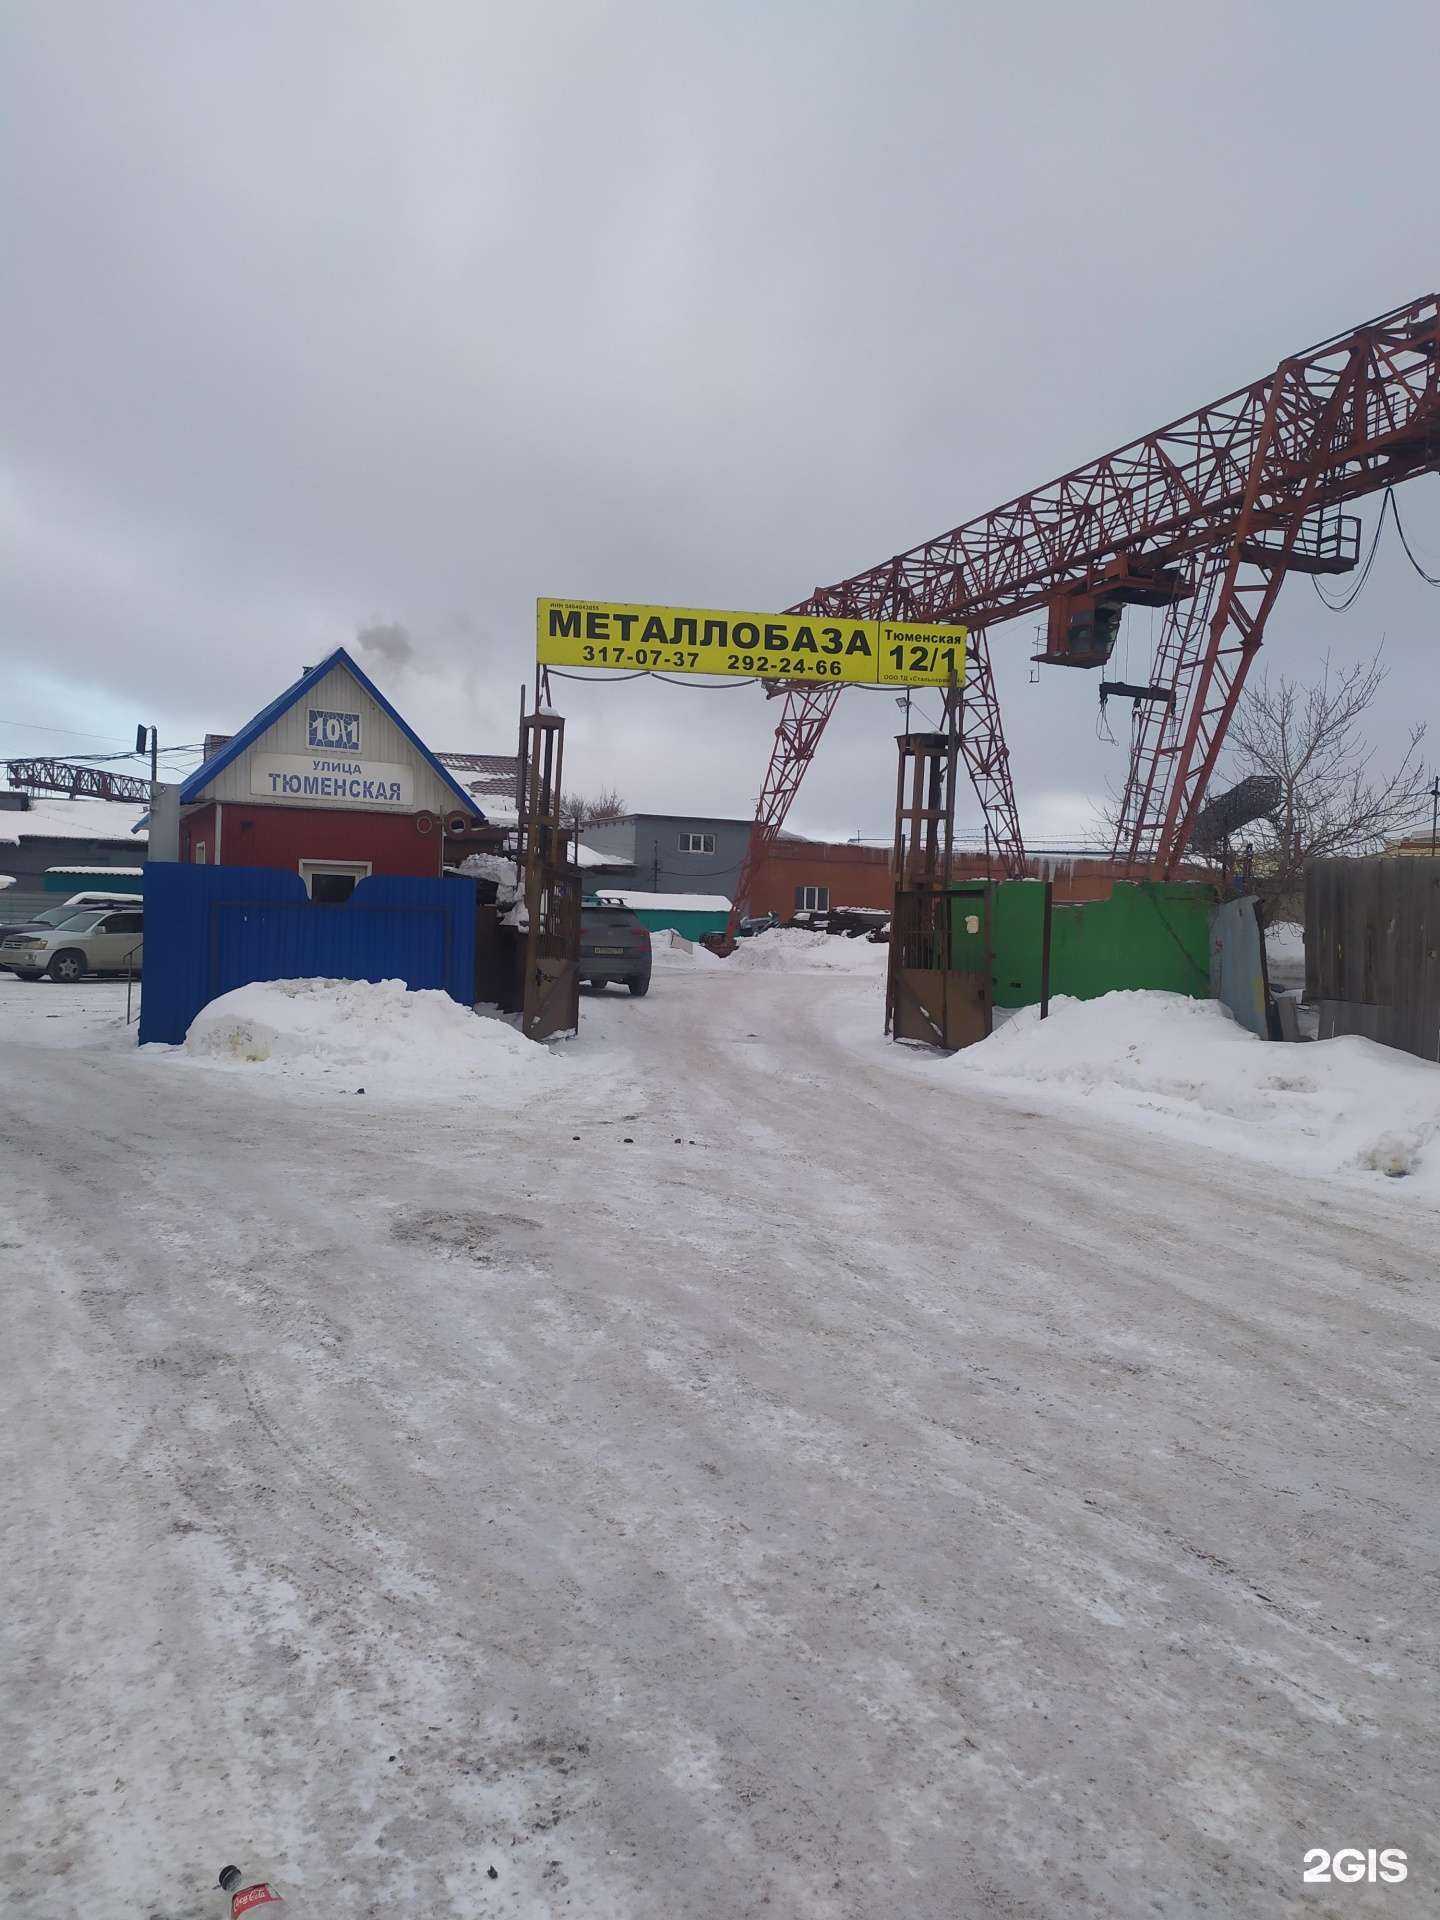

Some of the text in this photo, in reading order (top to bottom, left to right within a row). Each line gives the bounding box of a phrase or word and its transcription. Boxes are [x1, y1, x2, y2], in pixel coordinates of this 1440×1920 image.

[549, 609, 872, 656] МЕТАЛЛОБАЗА
[884, 629, 961, 645] Тюменская
[582, 645, 842, 676] 317-07-37 292-24-66
[889, 644, 955, 673] 12/1
[312, 760, 362, 775] УЛИЦА
[268, 773, 401, 801] ТЮМЕНСКАЯ
